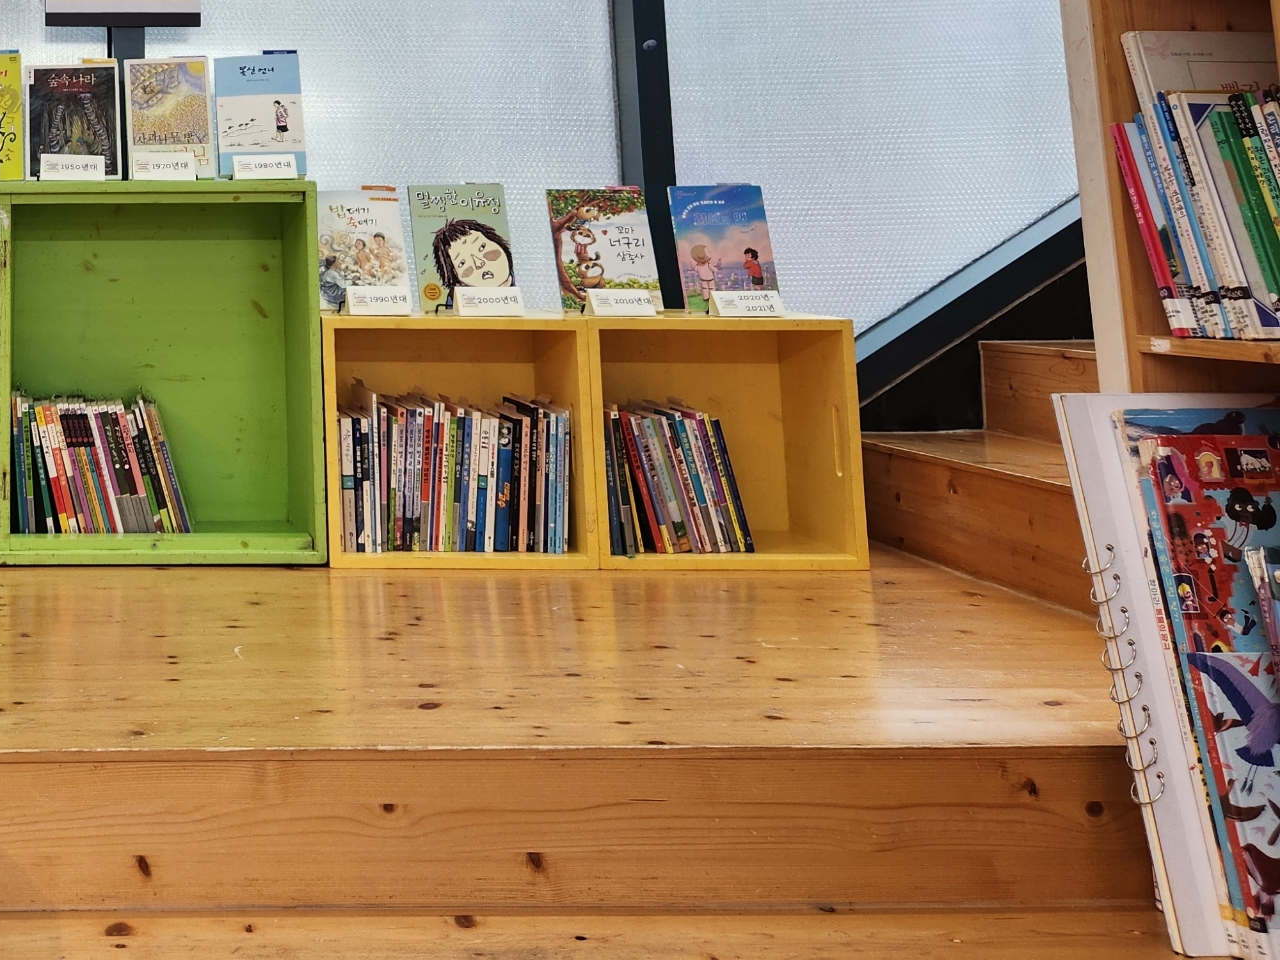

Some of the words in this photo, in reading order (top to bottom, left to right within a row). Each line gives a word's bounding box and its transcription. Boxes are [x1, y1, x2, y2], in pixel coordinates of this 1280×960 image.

[239, 65, 256, 77] 몽실
[257, 66, 275, 75] 언니
[136, 130, 180, 145] 사과나무
[60, 161, 98, 172] 1950년대
[152, 161, 189, 171] 1970년대
[253, 160, 292, 169] 1980년대
[415, 189, 459, 213] 멀쩡한
[459, 190, 501, 215] 이유정
[329, 204, 370, 219] 밥데기
[615, 225, 635, 234] 꼬마
[609, 236, 645, 249] 너구리
[616, 250, 645, 264] 삼총사
[369, 294, 408, 304] 1990년대
[477, 294, 519, 305] 2000년대
[745, 303, 776, 313] 2021년
[1149, 578, 1161, 606] 찾아라
